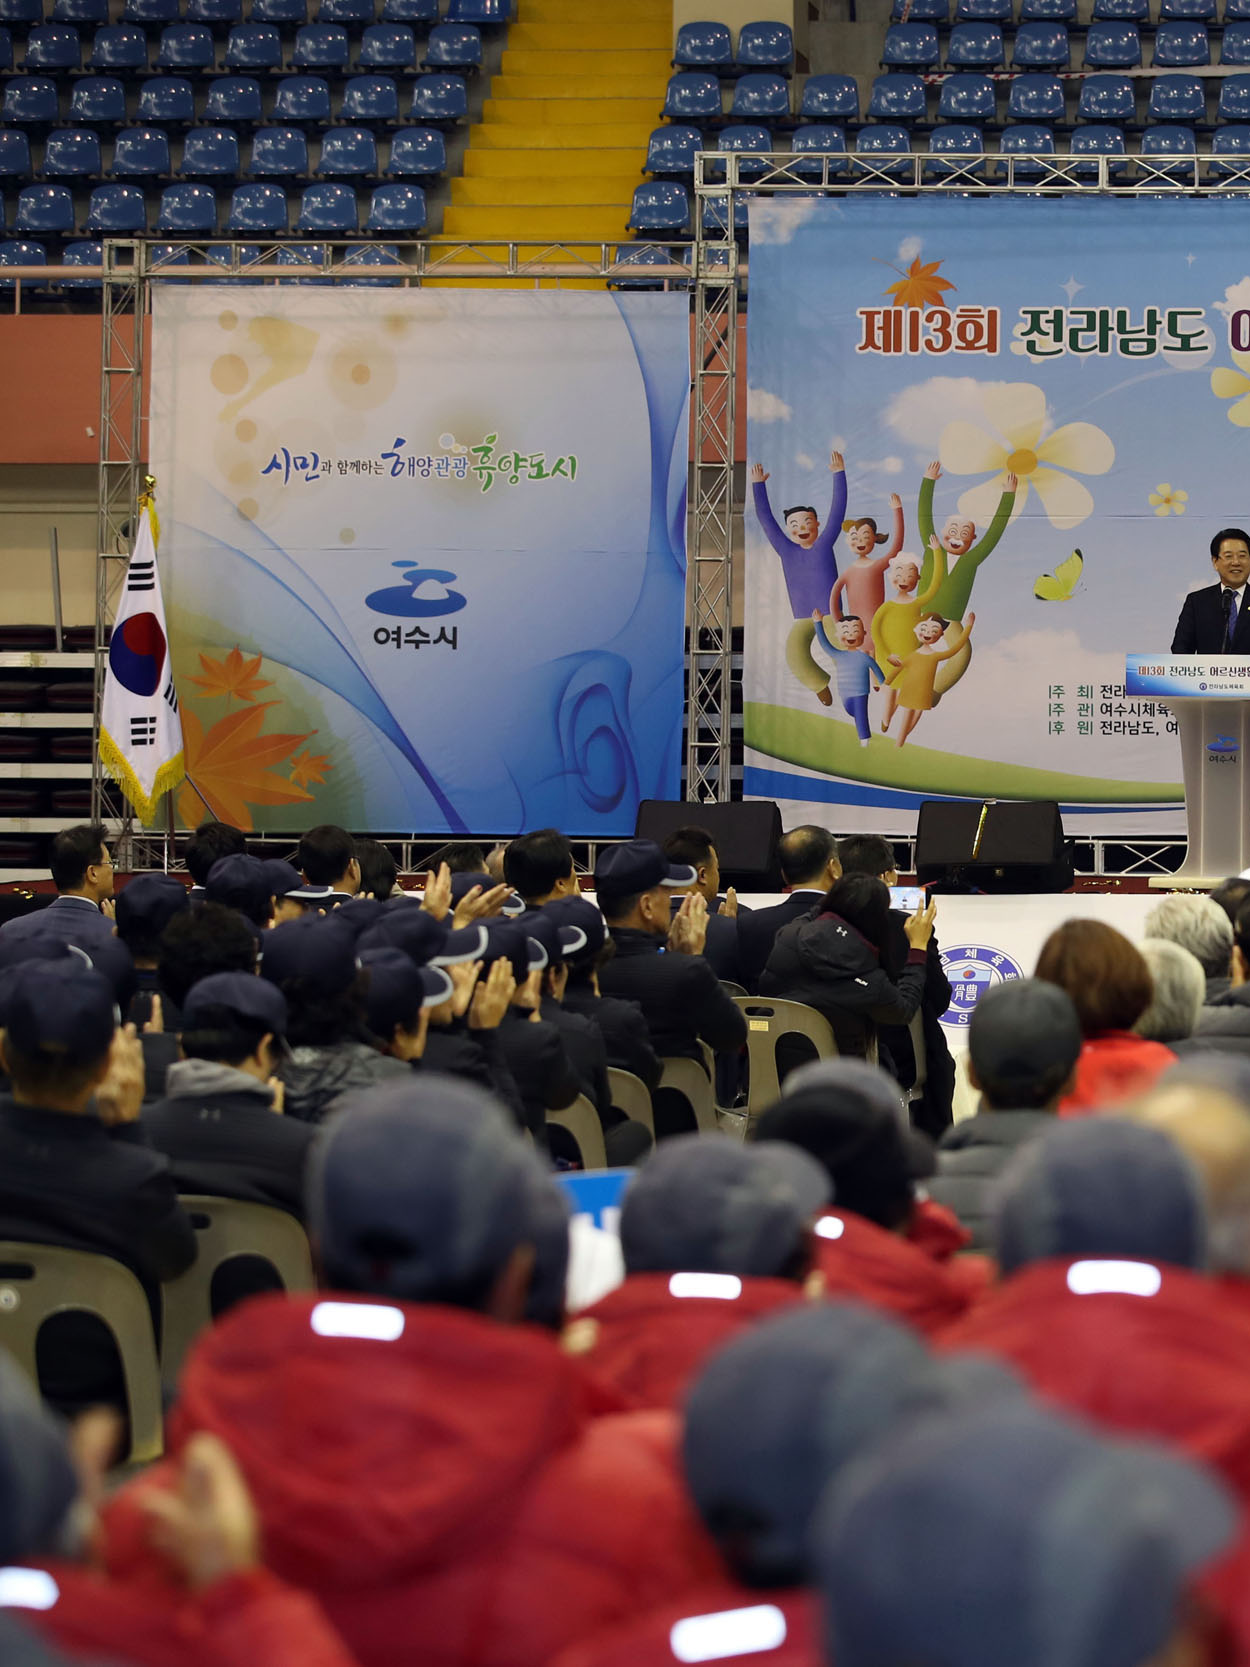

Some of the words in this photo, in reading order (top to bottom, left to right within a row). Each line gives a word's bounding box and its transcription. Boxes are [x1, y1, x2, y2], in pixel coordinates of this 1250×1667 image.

[857, 308, 998, 355] 제13회
[1020, 308, 1209, 357] 전라남도
[260, 446, 333, 485] 시민과
[337, 459, 385, 475] 함께하는
[470, 432, 578, 493] 휴양도시
[373, 625, 458, 650] 여수시
[1137, 665, 1166, 676] 제13회
[1169, 665, 1206, 677] 전라남도
[1100, 702, 1175, 718] 여수시체육
[1100, 720, 1160, 737] 전라남도,
[1208, 755, 1237, 764] 여수시
